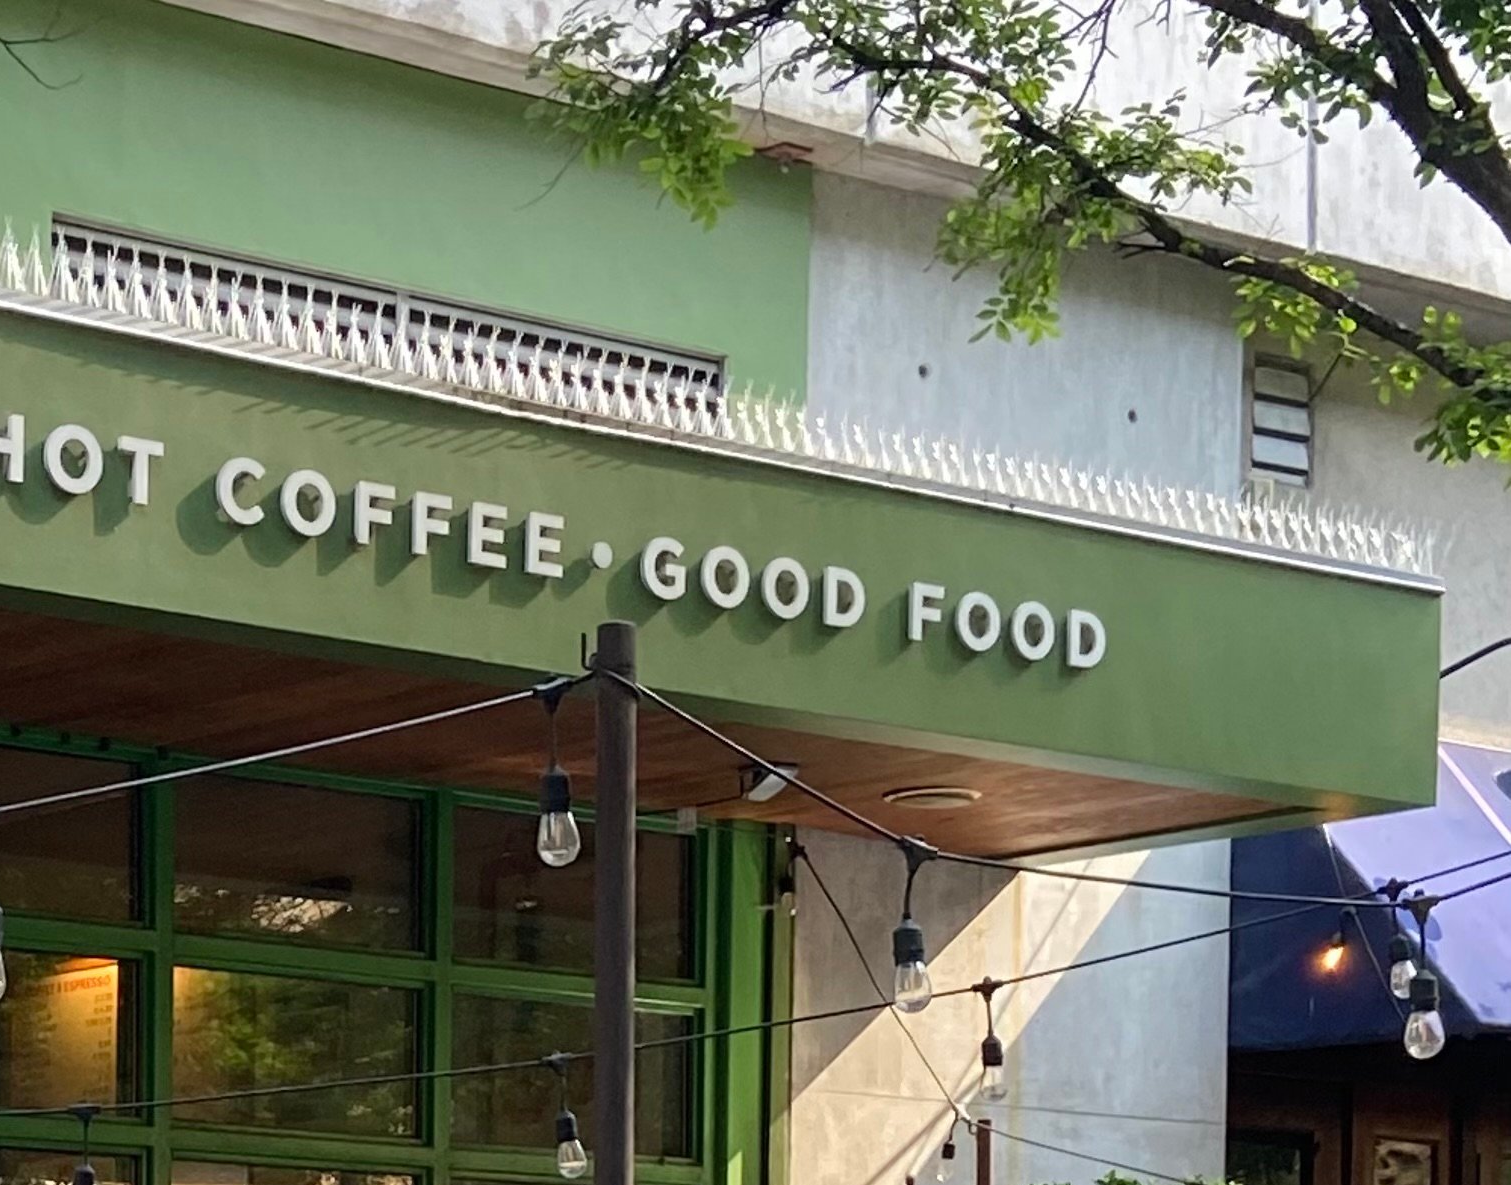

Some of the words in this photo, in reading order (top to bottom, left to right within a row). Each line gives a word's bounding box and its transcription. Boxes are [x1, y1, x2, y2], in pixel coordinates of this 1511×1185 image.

[216, 457, 566, 578] COFFEE
[640, 536, 866, 628] GOOD
[908, 581, 1106, 669] FOOD
